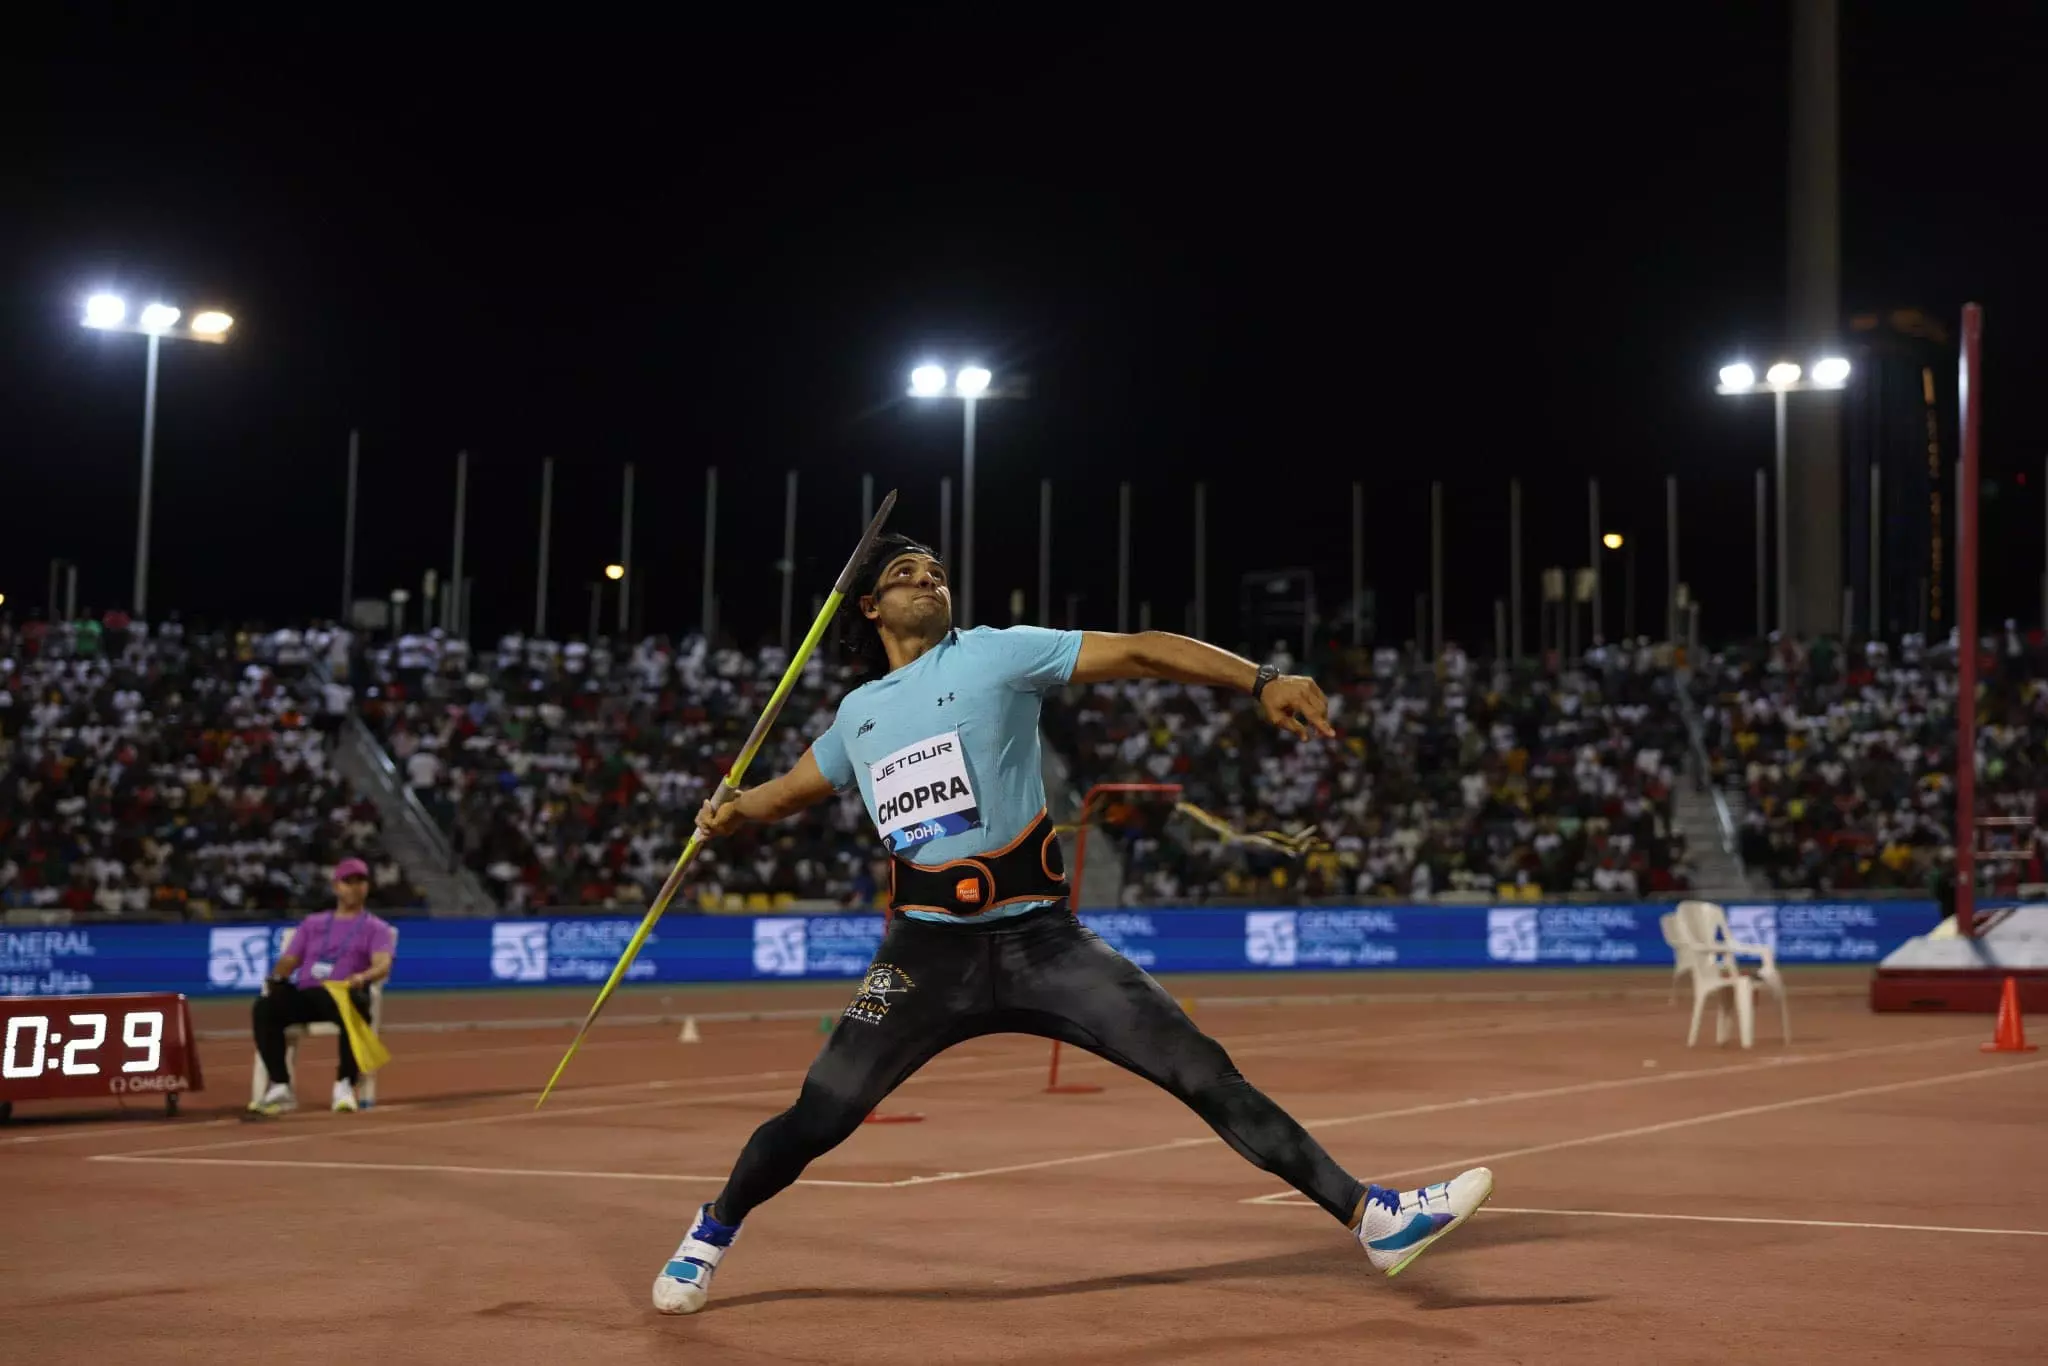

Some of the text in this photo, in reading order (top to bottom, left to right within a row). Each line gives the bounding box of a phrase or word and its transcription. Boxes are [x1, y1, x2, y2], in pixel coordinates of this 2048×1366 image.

[875, 741, 953, 782] JETOUR
[878, 775, 970, 825] CHOPRA
[905, 822, 945, 843] DOHA
[1299, 911, 1398, 933] GENERAL
[1540, 908, 1639, 930] GENERAL
[1780, 905, 1878, 927] GENERAL
[3, 1012, 163, 1079] 0:29
[129, 1075, 189, 1092] OMEGA
